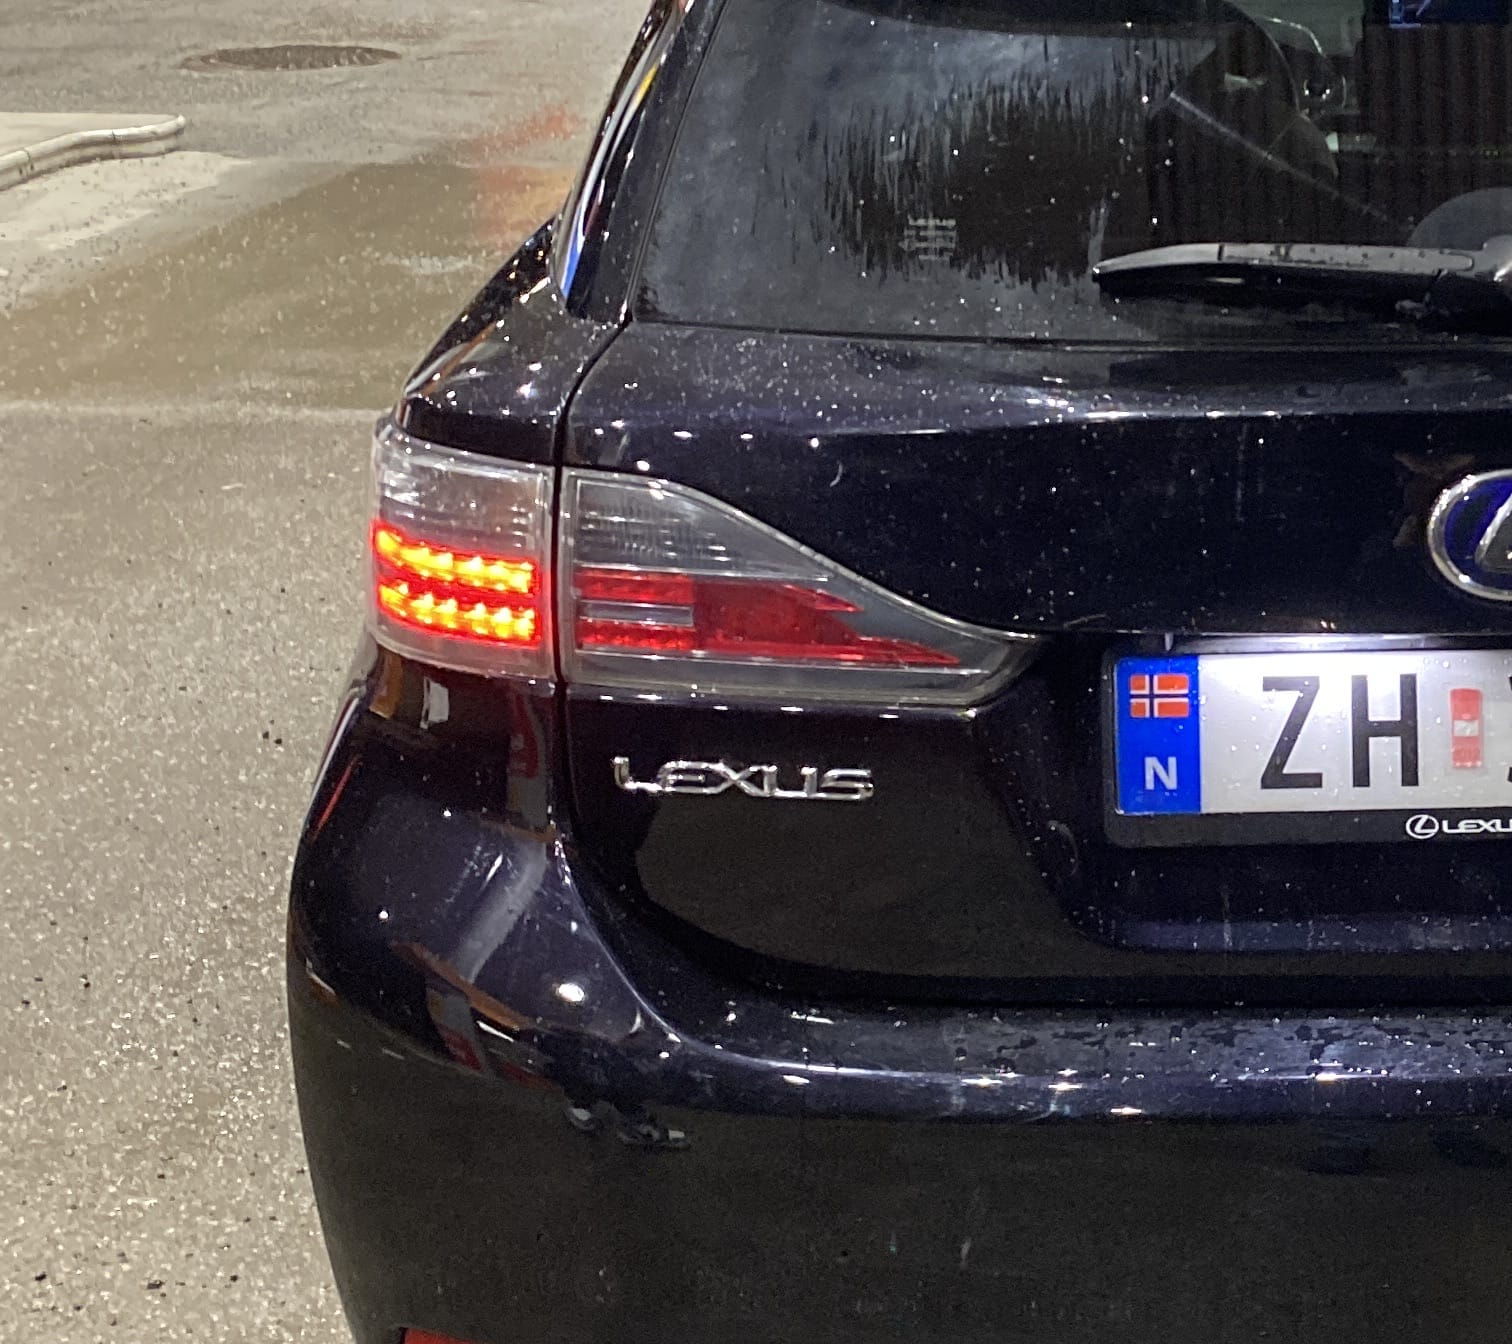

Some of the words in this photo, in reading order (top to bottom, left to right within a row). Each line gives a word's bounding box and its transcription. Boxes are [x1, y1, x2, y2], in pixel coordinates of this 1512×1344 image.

[1260, 672, 1420, 790] ZH
[611, 755, 874, 801] LEXUS
[1143, 756, 1180, 791] N
